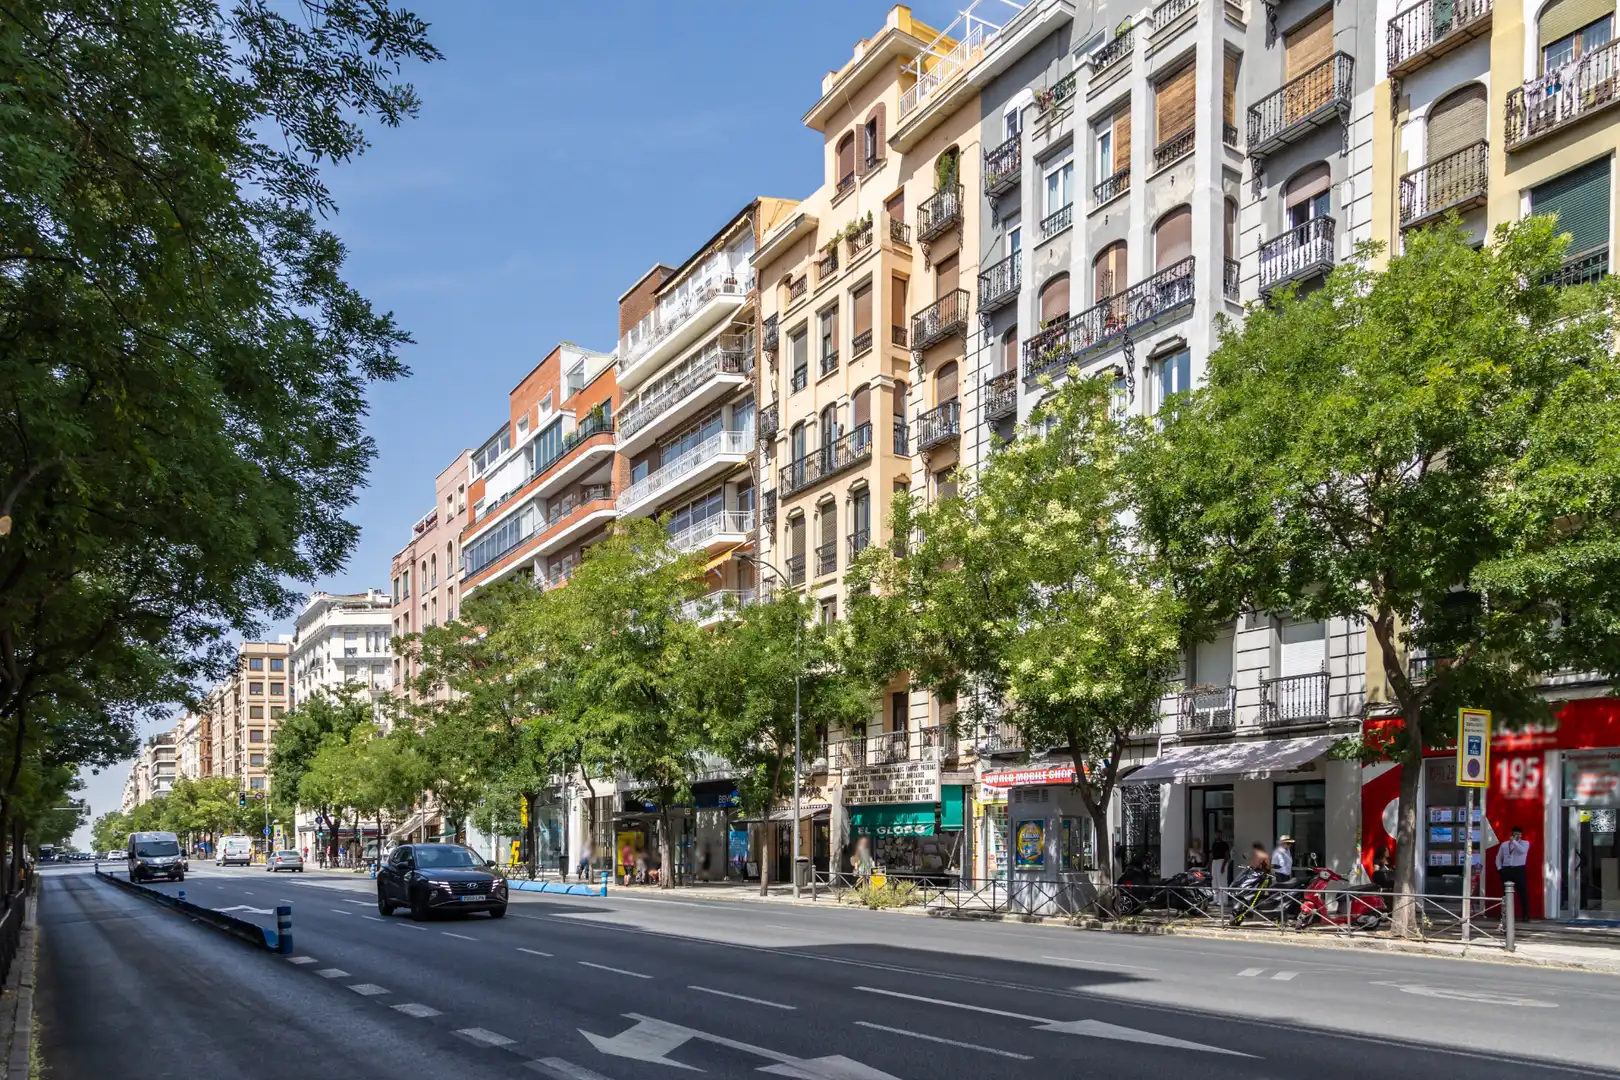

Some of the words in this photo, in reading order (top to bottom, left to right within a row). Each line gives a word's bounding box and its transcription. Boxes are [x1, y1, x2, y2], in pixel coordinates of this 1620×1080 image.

[985, 774, 1014, 784] WORLD
[1016, 770, 1048, 781] MOBILE
[1048, 769, 1074, 779] SHOP
[1498, 758, 1540, 792] 195
[876, 825, 926, 834] GLOBO
